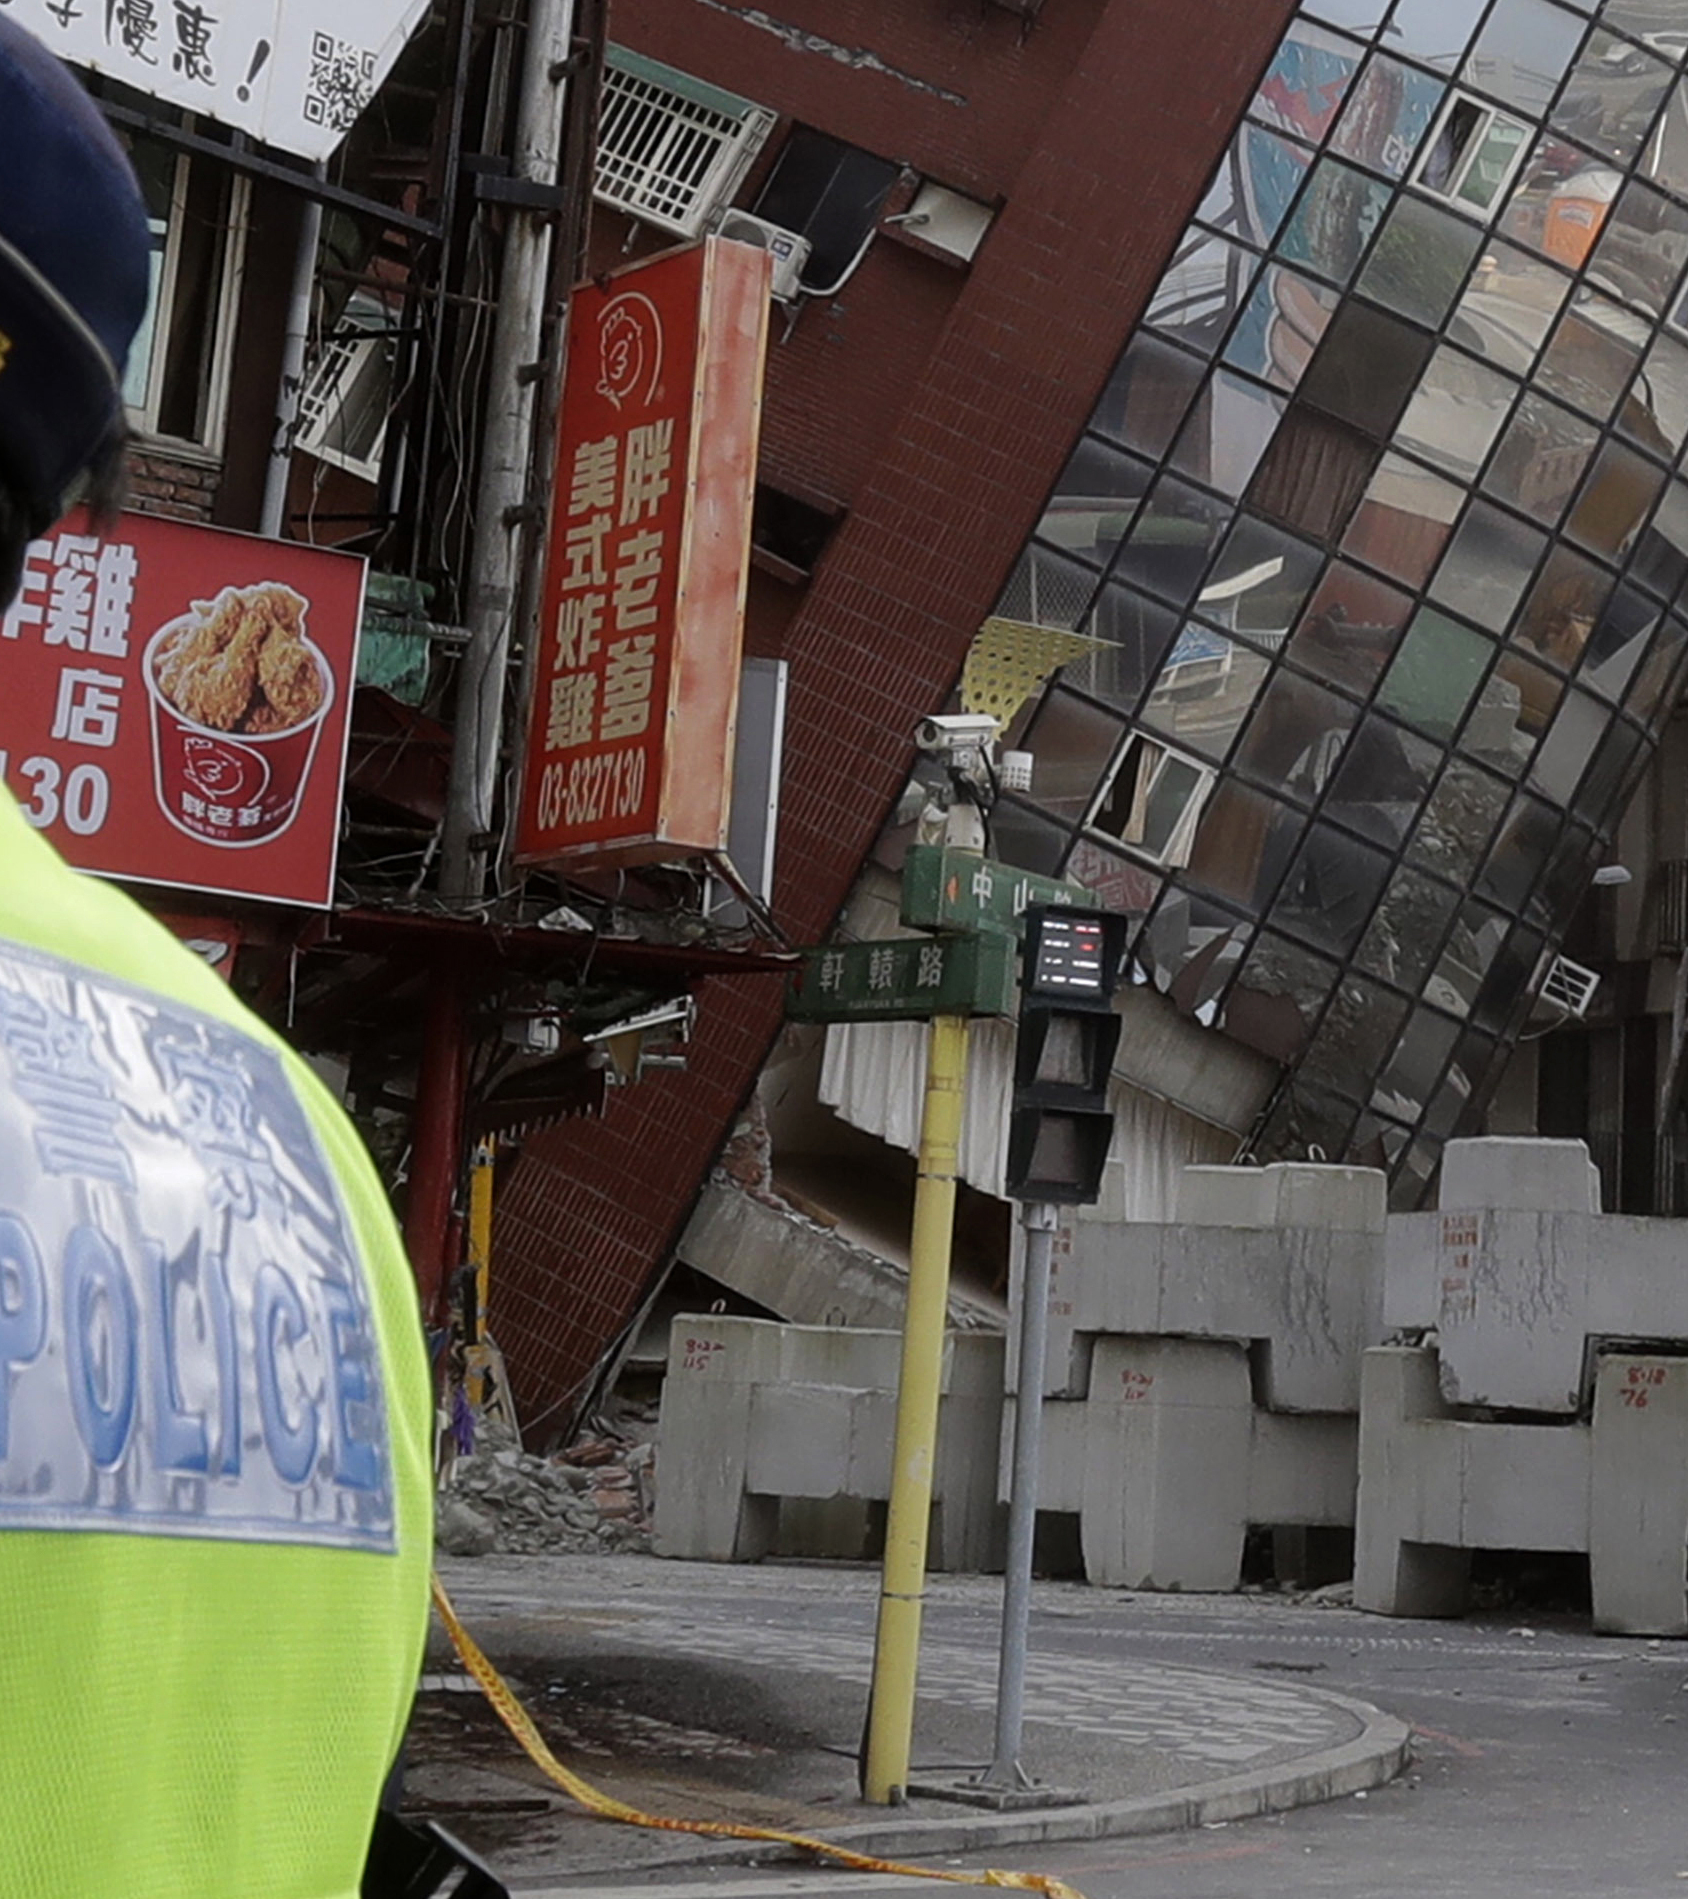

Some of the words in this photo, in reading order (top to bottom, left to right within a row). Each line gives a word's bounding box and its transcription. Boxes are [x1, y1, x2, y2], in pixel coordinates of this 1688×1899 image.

[544, 435, 618, 753] 美式炸雞
[599, 418, 675, 744] 胖老爹
[537, 747, 646, 832] 03-8327130
[819, 944, 945, 992] 軒轅路
